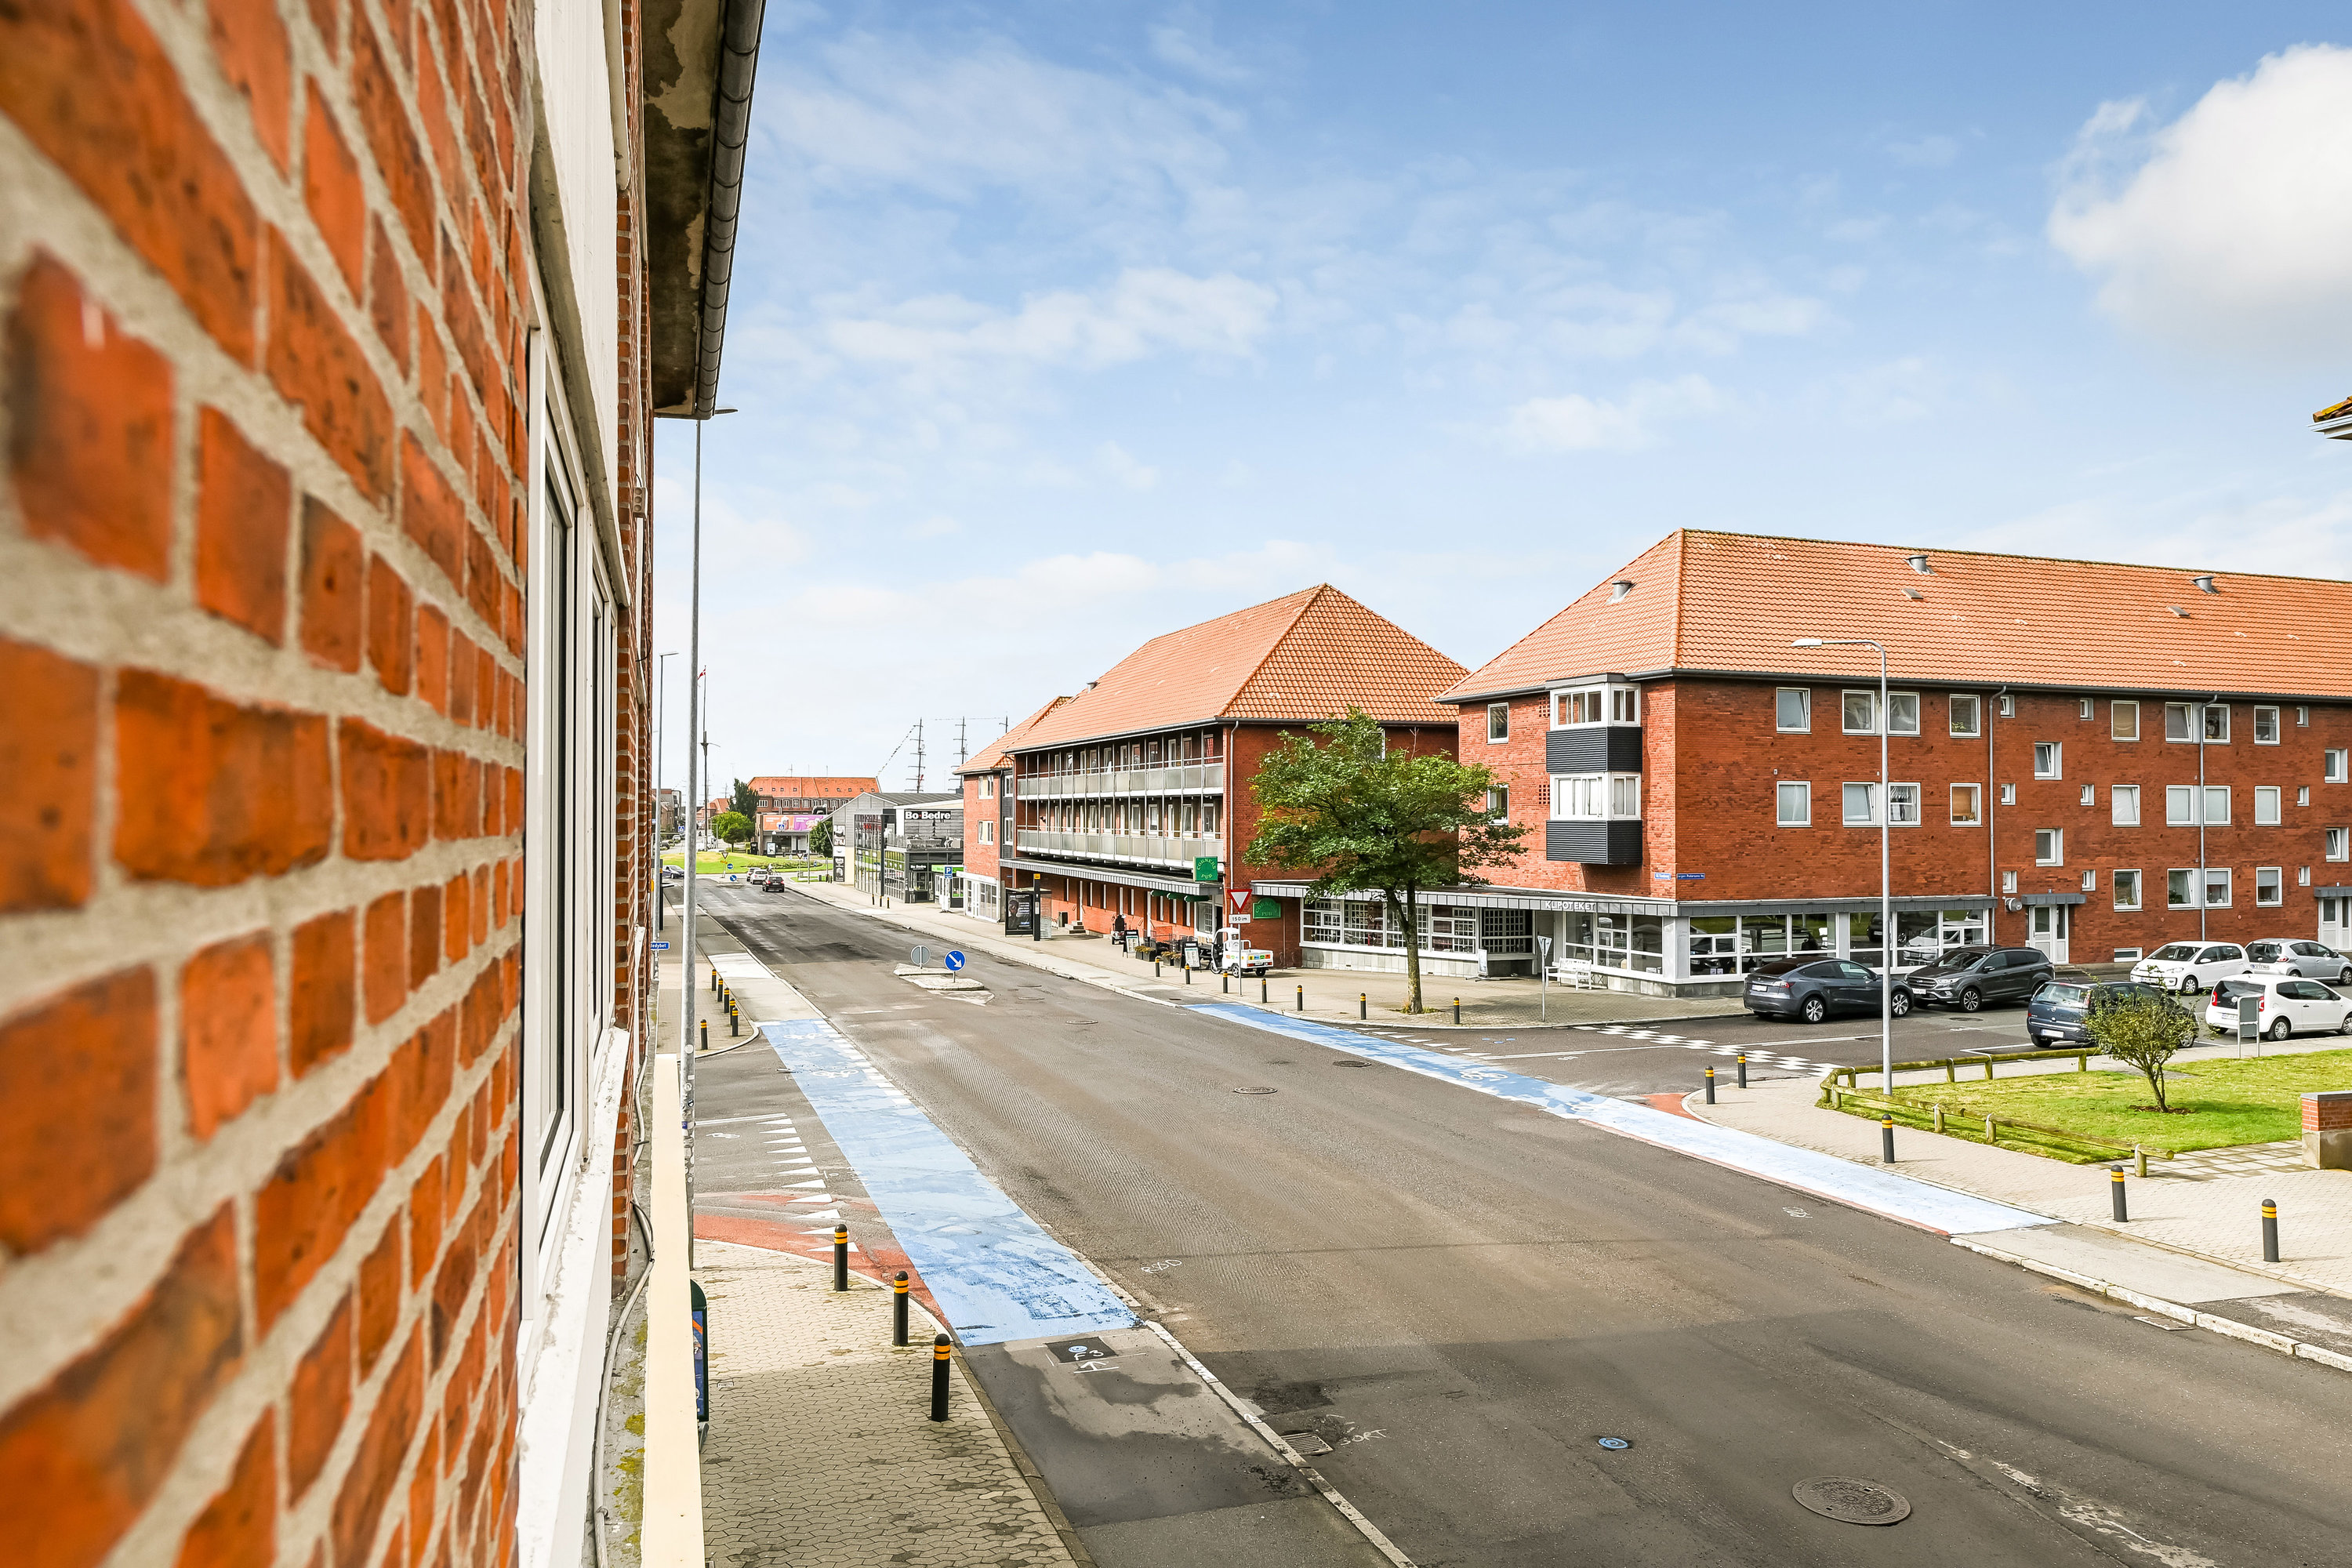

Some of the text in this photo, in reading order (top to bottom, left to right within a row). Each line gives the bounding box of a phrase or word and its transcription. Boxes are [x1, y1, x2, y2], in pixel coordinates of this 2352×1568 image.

[921, 811, 951, 819] Bedre
[1197, 858, 1216, 870] CORNERS
[1545, 900, 1596, 911] KLIPOTEKET
